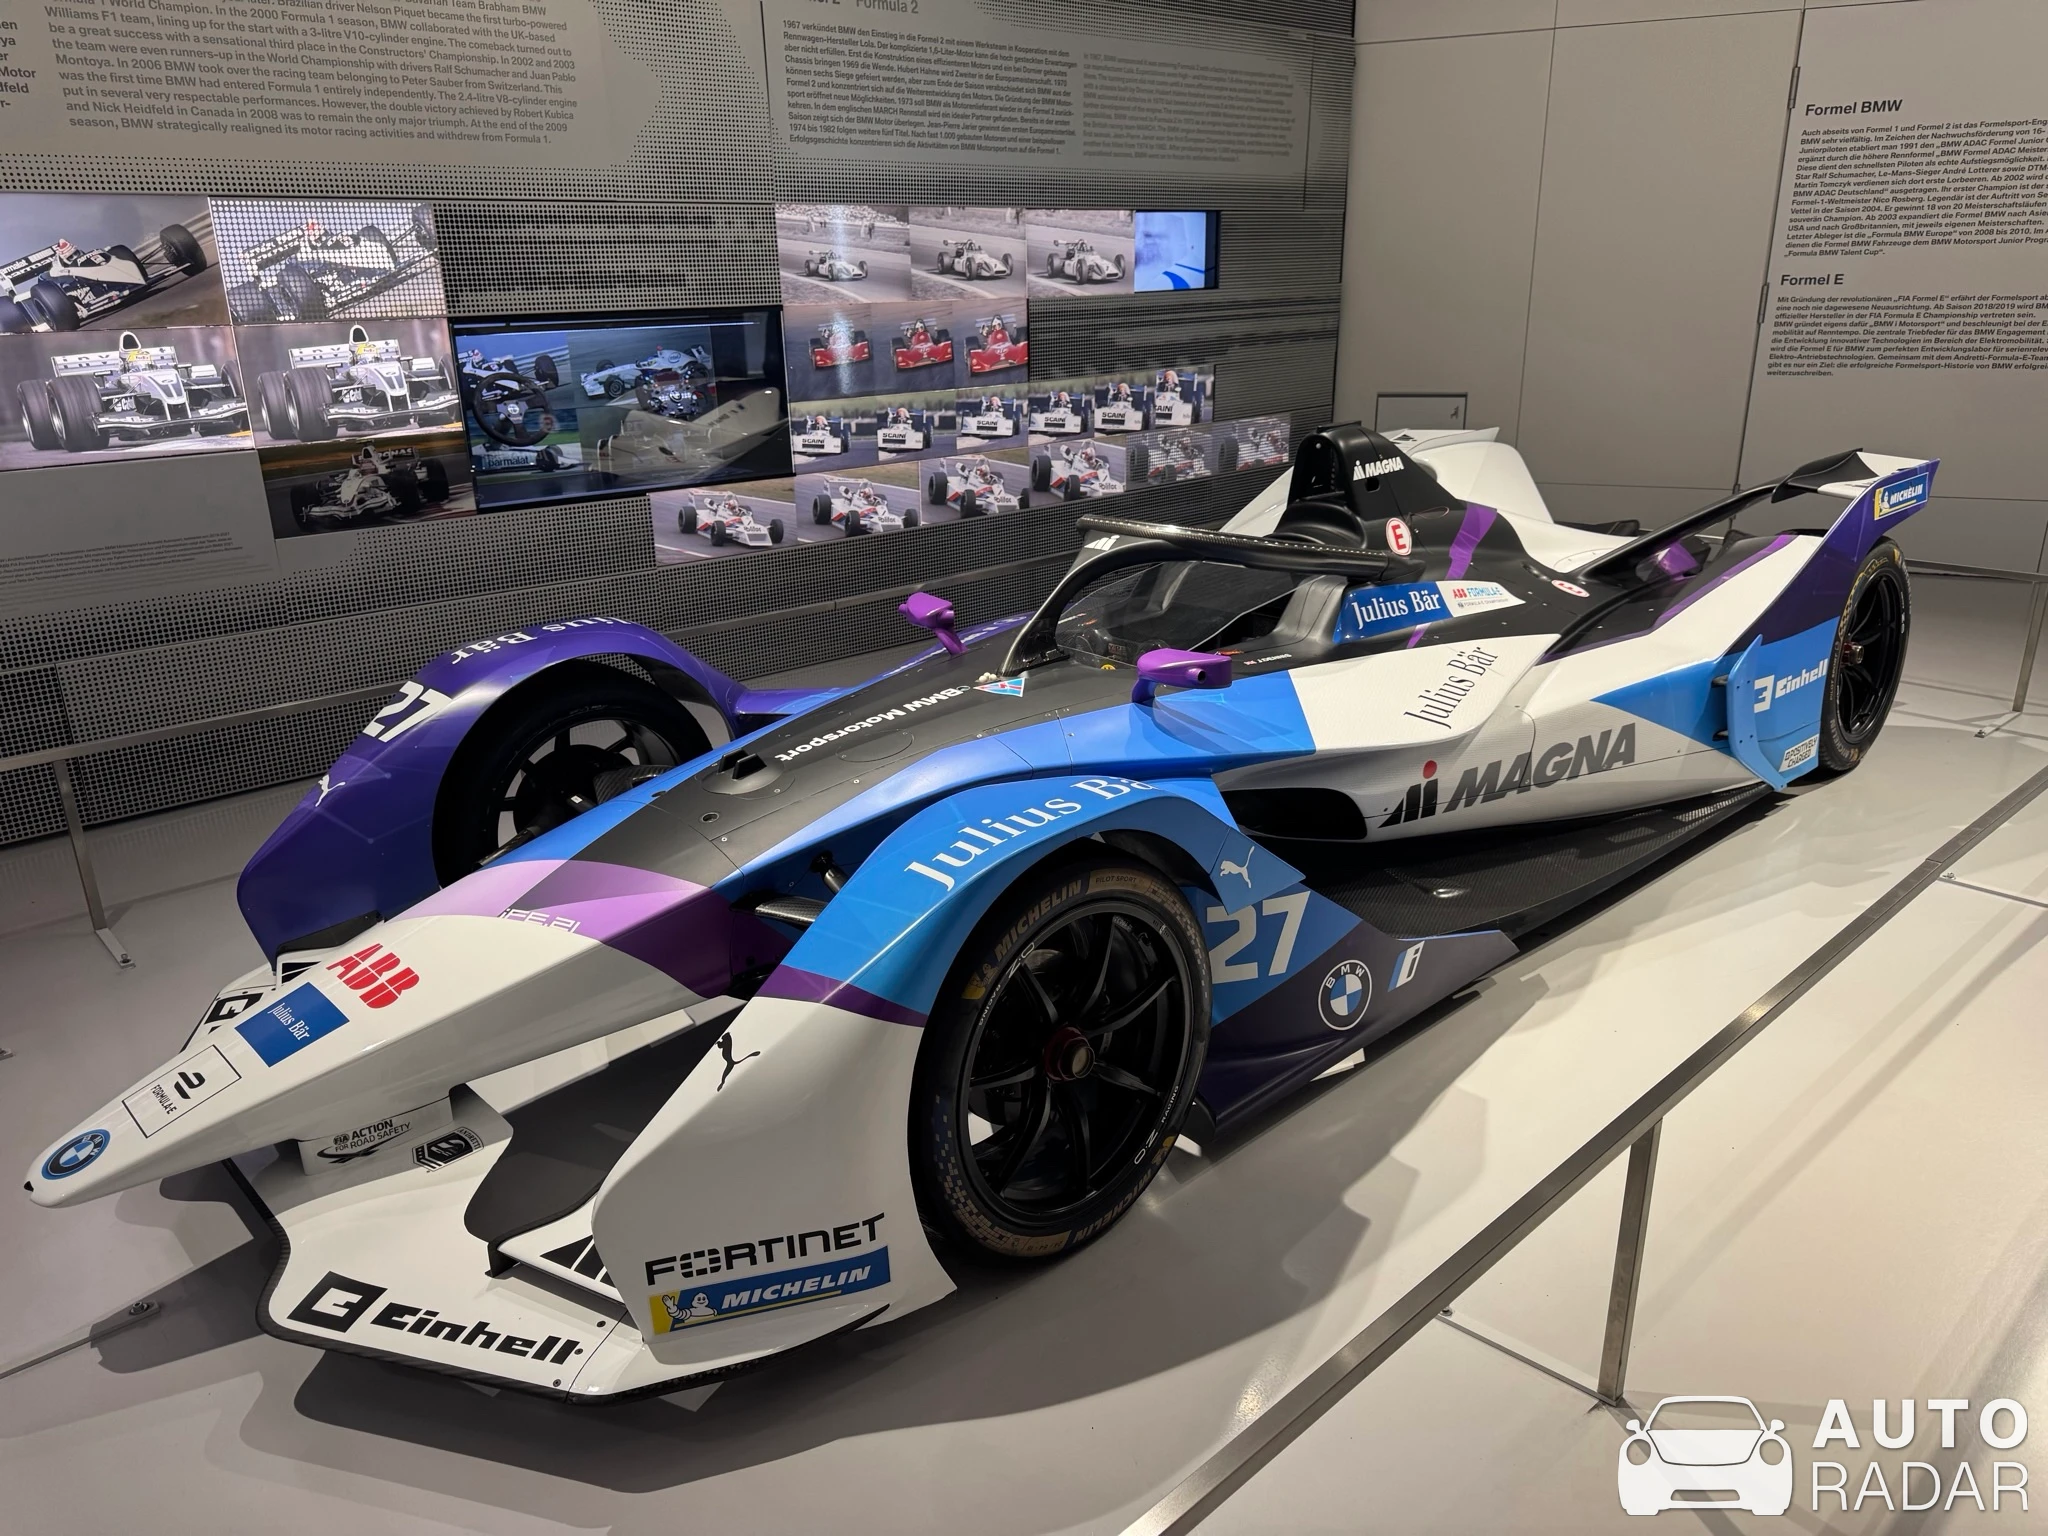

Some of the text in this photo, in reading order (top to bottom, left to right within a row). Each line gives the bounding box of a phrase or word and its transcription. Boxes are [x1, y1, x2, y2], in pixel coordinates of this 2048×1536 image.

[45, 6, 99, 21] Williams
[102, 10, 116, 22] F1
[120, 13, 154, 26] team,
[157, 15, 189, 29] lining
[193, 21, 206, 30] up
[210, 19, 224, 30] for
[227, 21, 245, 31] the
[248, 23, 273, 34] start
[275, 25, 299, 36] with
[310, 27, 341, 39] 3-litre
[344, 30, 410, 44] V10-cylinder
[412, 37, 447, 48] engine.
[448, 38, 467, 48] The
[469, 41, 514, 52] comeback
[516, 44, 545, 55] turned
[547, 47, 561, 56] out
[563, 48, 572, 57] to
[56, 54, 563, 94] Montoya. In 2006 BMW took over the racing team belonging to Peter Sauber from Switzerland. This
[1805, 99, 1903, 116] Formel BMW
[1917, 123, 1943, 131] Formel
[69, 117, 551, 144] season, BMW strategically realigned its motor racing activities and withdrew from Formula 1.
[1781, 274, 1844, 286] Formel E
[1922, 312, 1978, 320] Championship
[1365, 457, 1404, 478] MAGNA
[1890, 484, 1924, 505] MICHELIN
[1391, 524, 1407, 550] E
[1351, 590, 1441, 630] Julius Bär
[1452, 588, 1468, 599] ABB
[1403, 675, 1476, 730] Julius
[1447, 647, 1499, 678] Bär
[1775, 658, 1829, 699] Einhell
[363, 680, 451, 742] 27
[775, 688, 964, 762] BMW Motorsport
[1442, 722, 1636, 814] MAGNA
[904, 796, 1082, 892] Julius
[1116, 875, 1137, 883] SPORT
[994, 880, 1082, 962] MICHELIN
[1207, 891, 1311, 984] 27
[325, 943, 420, 1009] ABB
[267, 1002, 310, 1041] Julius Bär
[335, 1121, 411, 1153] FOR ROAD SAFETY
[352, 1119, 394, 1141] ACTION
[644, 1212, 885, 1287] FORTINET
[721, 1265, 871, 1310] MICHELIN
[370, 1302, 581, 1366] Einhell
